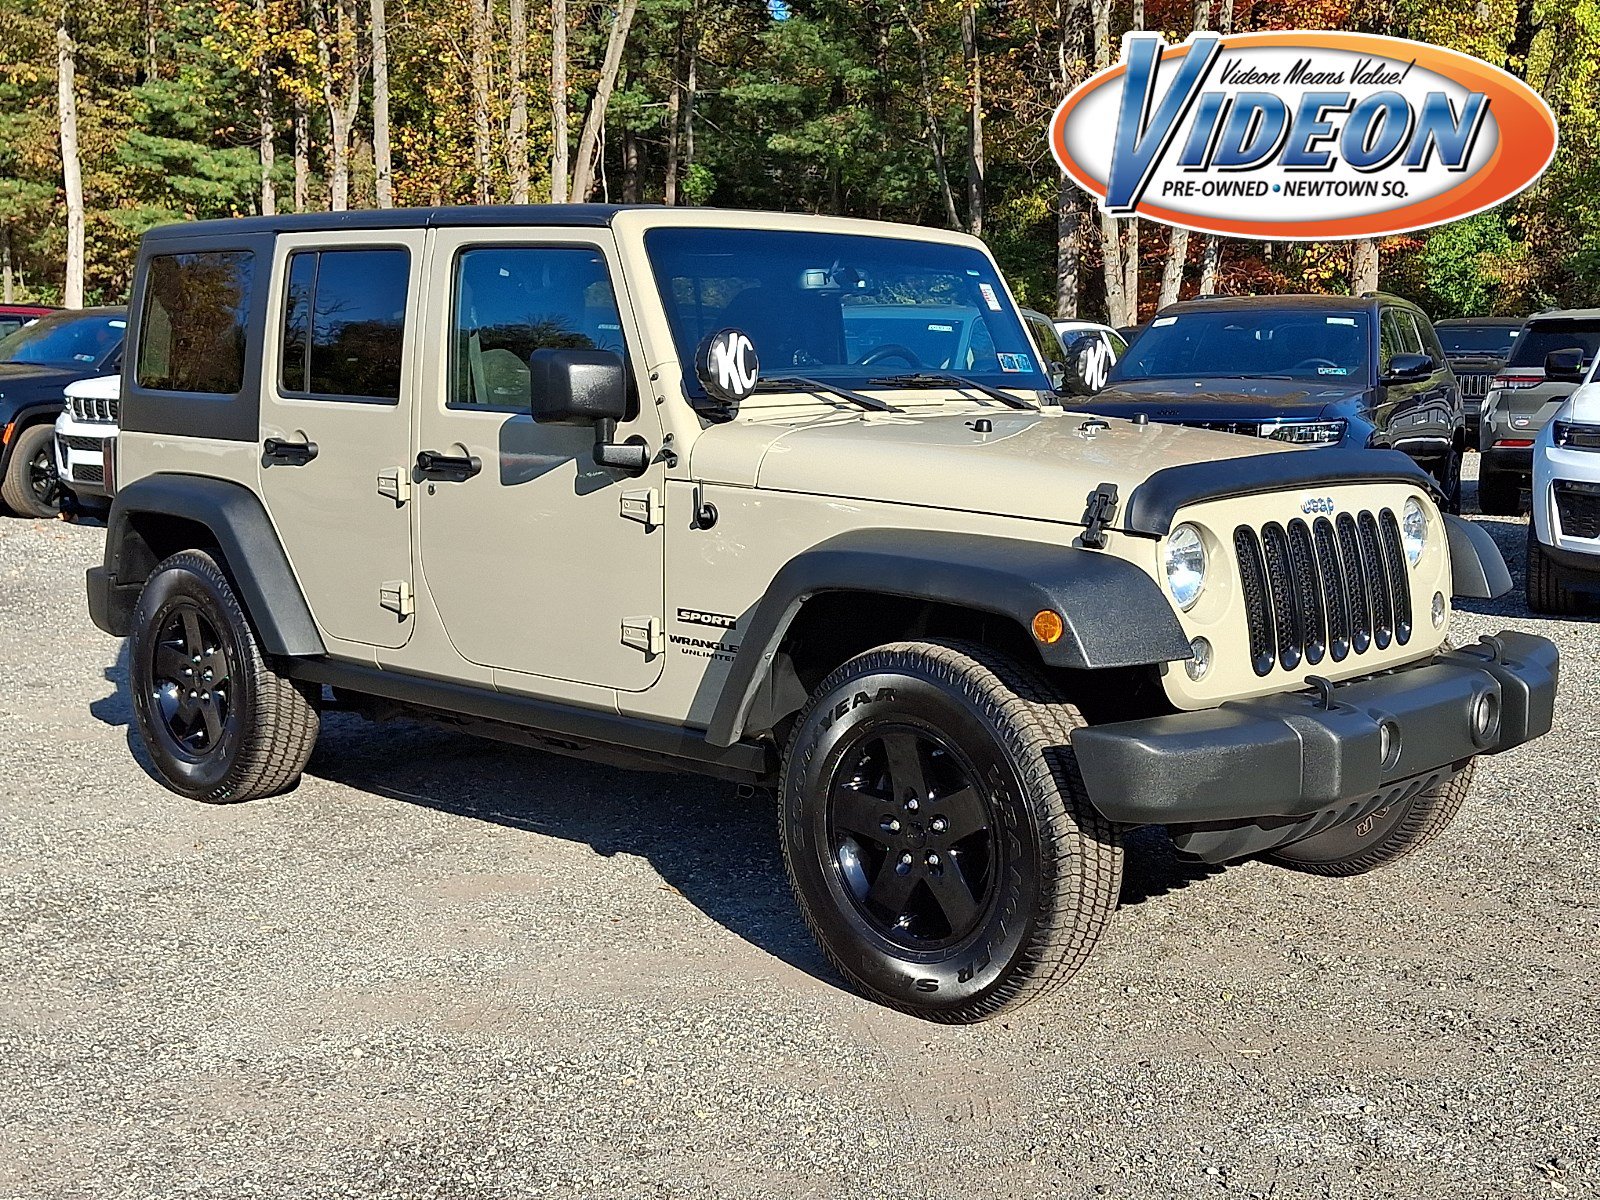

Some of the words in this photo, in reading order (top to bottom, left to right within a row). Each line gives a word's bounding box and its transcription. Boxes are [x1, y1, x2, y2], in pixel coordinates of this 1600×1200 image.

[715, 332, 757, 395] KC
[1085, 339, 1108, 391] KC
[1300, 496, 1335, 516] Jeep
[680, 610, 737, 627] SPORT
[669, 634, 740, 654] WRANGLE
